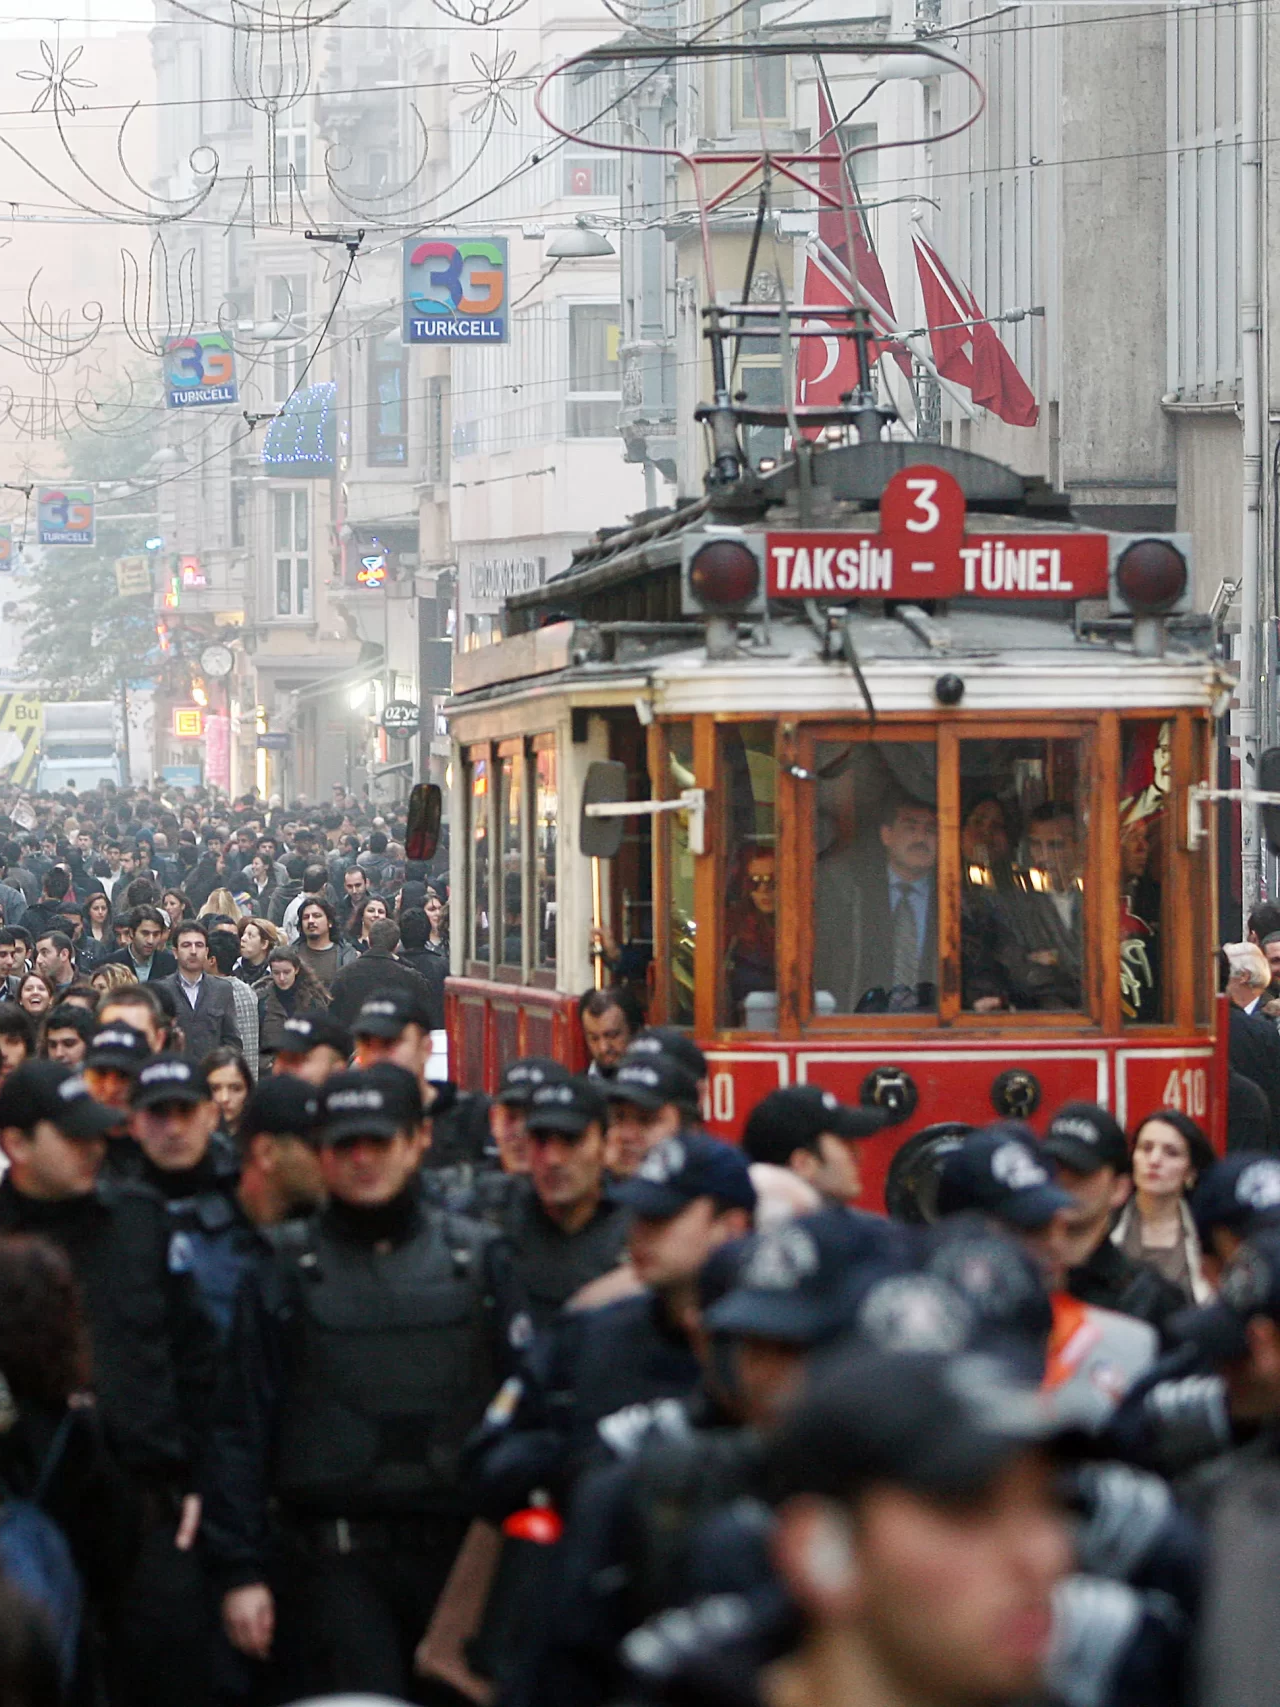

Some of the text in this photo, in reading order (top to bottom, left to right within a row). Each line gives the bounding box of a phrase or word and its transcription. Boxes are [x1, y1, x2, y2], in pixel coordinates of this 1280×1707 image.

[409, 242, 504, 315] 3G
[413, 320, 500, 337] TURKCELL
[167, 334, 233, 387] 3G
[172, 388, 233, 404] TURKCELL
[41, 491, 93, 530] 3G
[905, 478, 940, 533] 3
[771, 540, 893, 591] TAKSİM
[959, 541, 1073, 591] TÜNEL
[1162, 1068, 1207, 1117] 410
